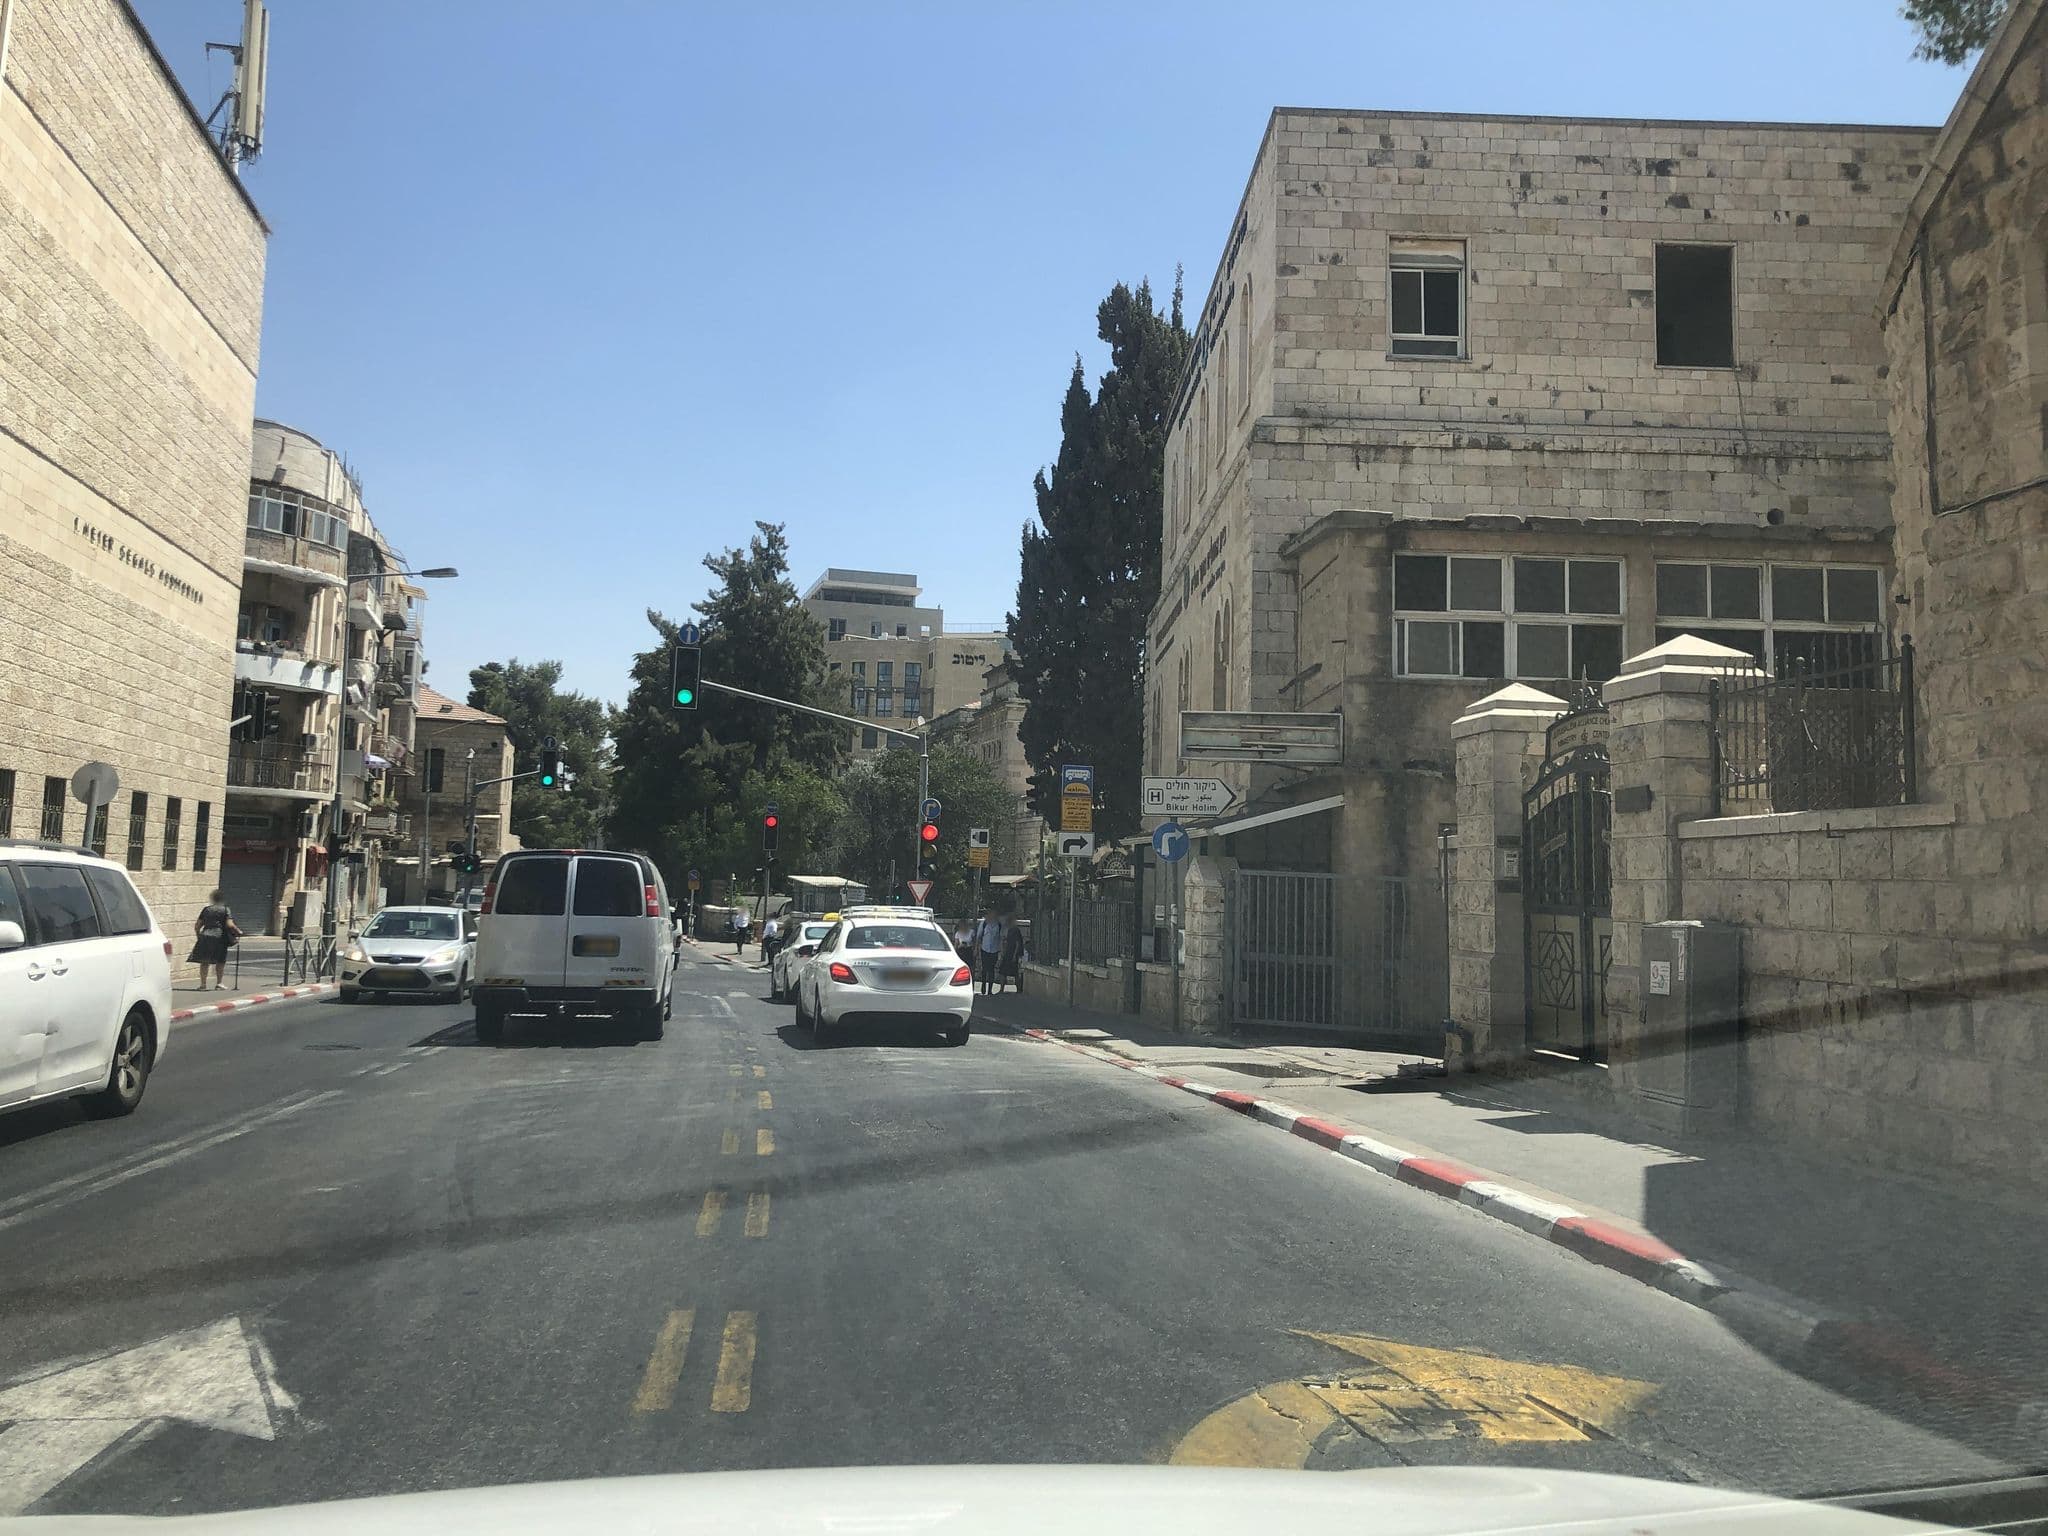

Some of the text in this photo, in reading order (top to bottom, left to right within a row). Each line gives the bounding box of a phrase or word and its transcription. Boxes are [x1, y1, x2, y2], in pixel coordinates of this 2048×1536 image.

[82, 522, 115, 554] MEIER
[118, 544, 156, 579] SEGALS
[1165, 779, 1217, 793] ביקור חולים
[1165, 803, 1188, 812] Bikur
